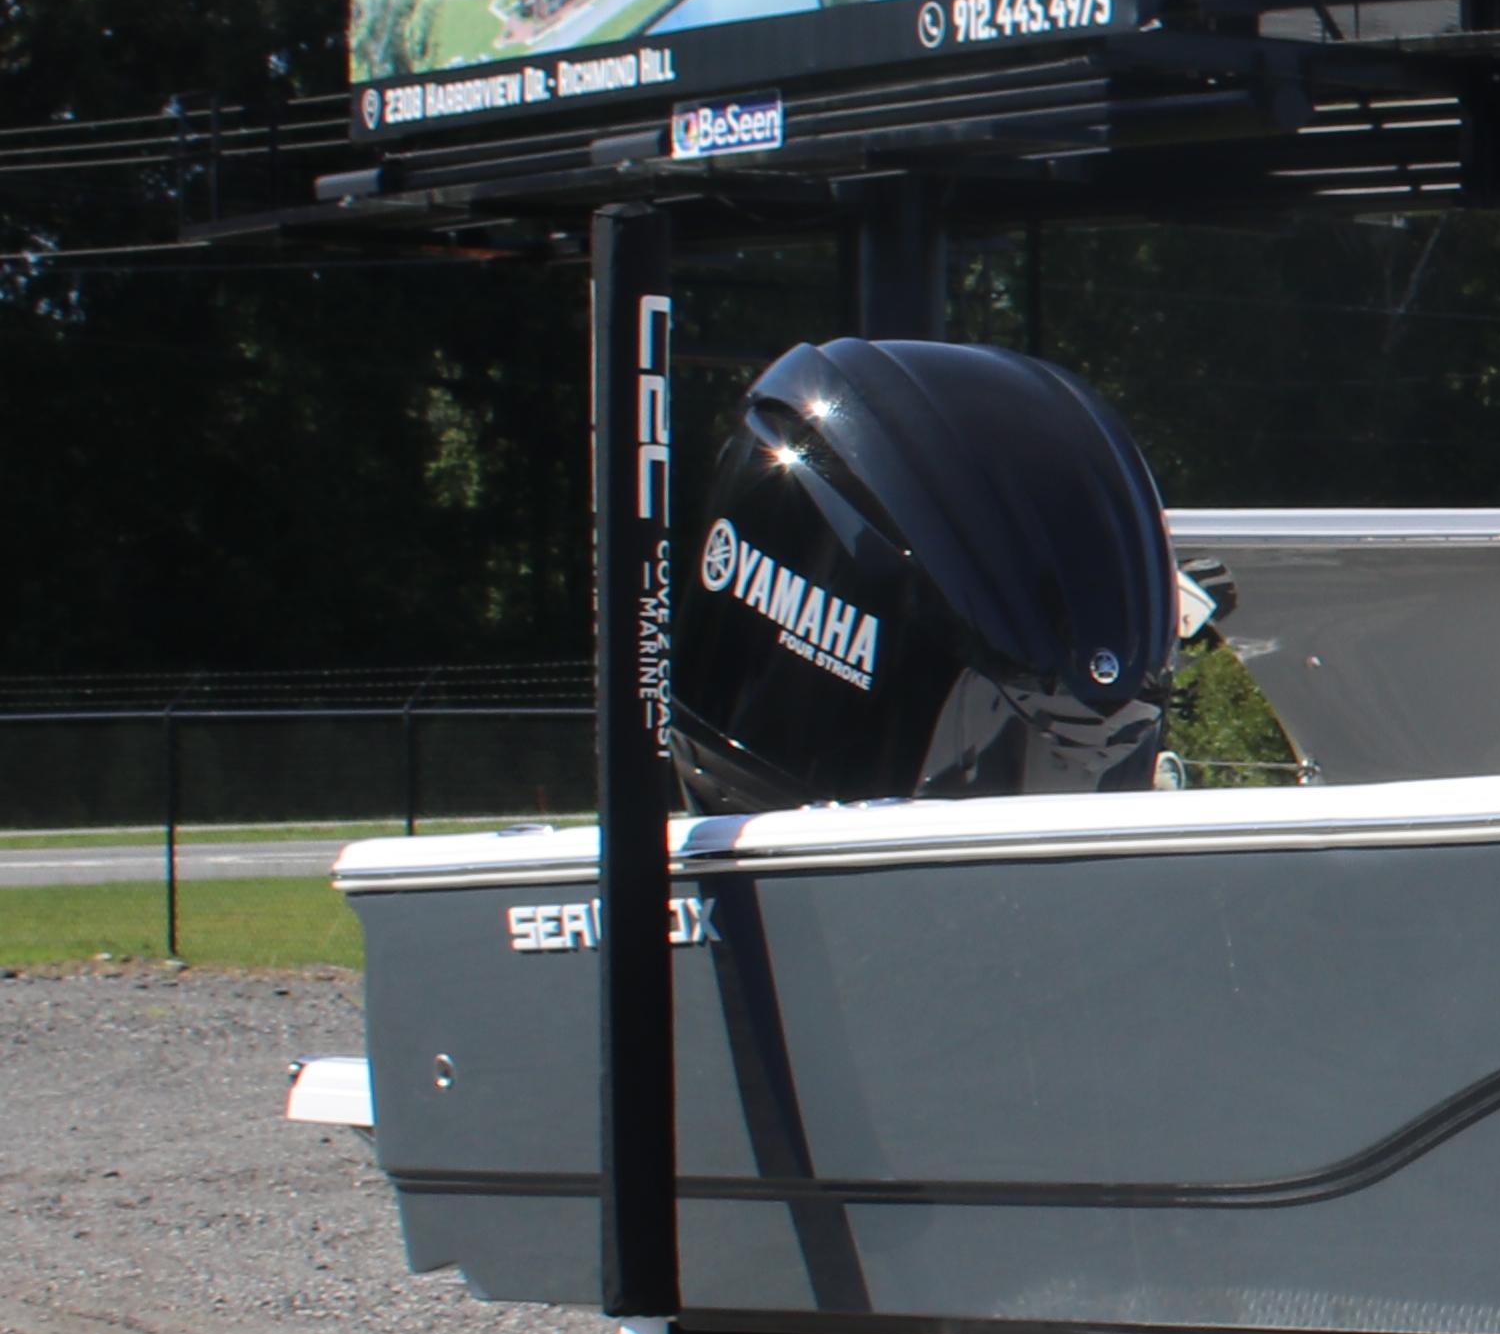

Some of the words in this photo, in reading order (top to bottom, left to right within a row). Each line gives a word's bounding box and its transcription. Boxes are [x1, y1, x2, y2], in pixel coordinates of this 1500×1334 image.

[425, 72, 522, 118] HARBORVIEW
[557, 54, 637, 97] RICHMOND
[639, 47, 676, 84] HILL
[699, 103, 780, 146] BeSeen
[734, 540, 880, 673] YAMAHA
[639, 597, 660, 700] MARINE
[778, 629, 816, 661] FOUR
[816, 650, 873, 691] STROKE
[508, 903, 594, 951] SEA
